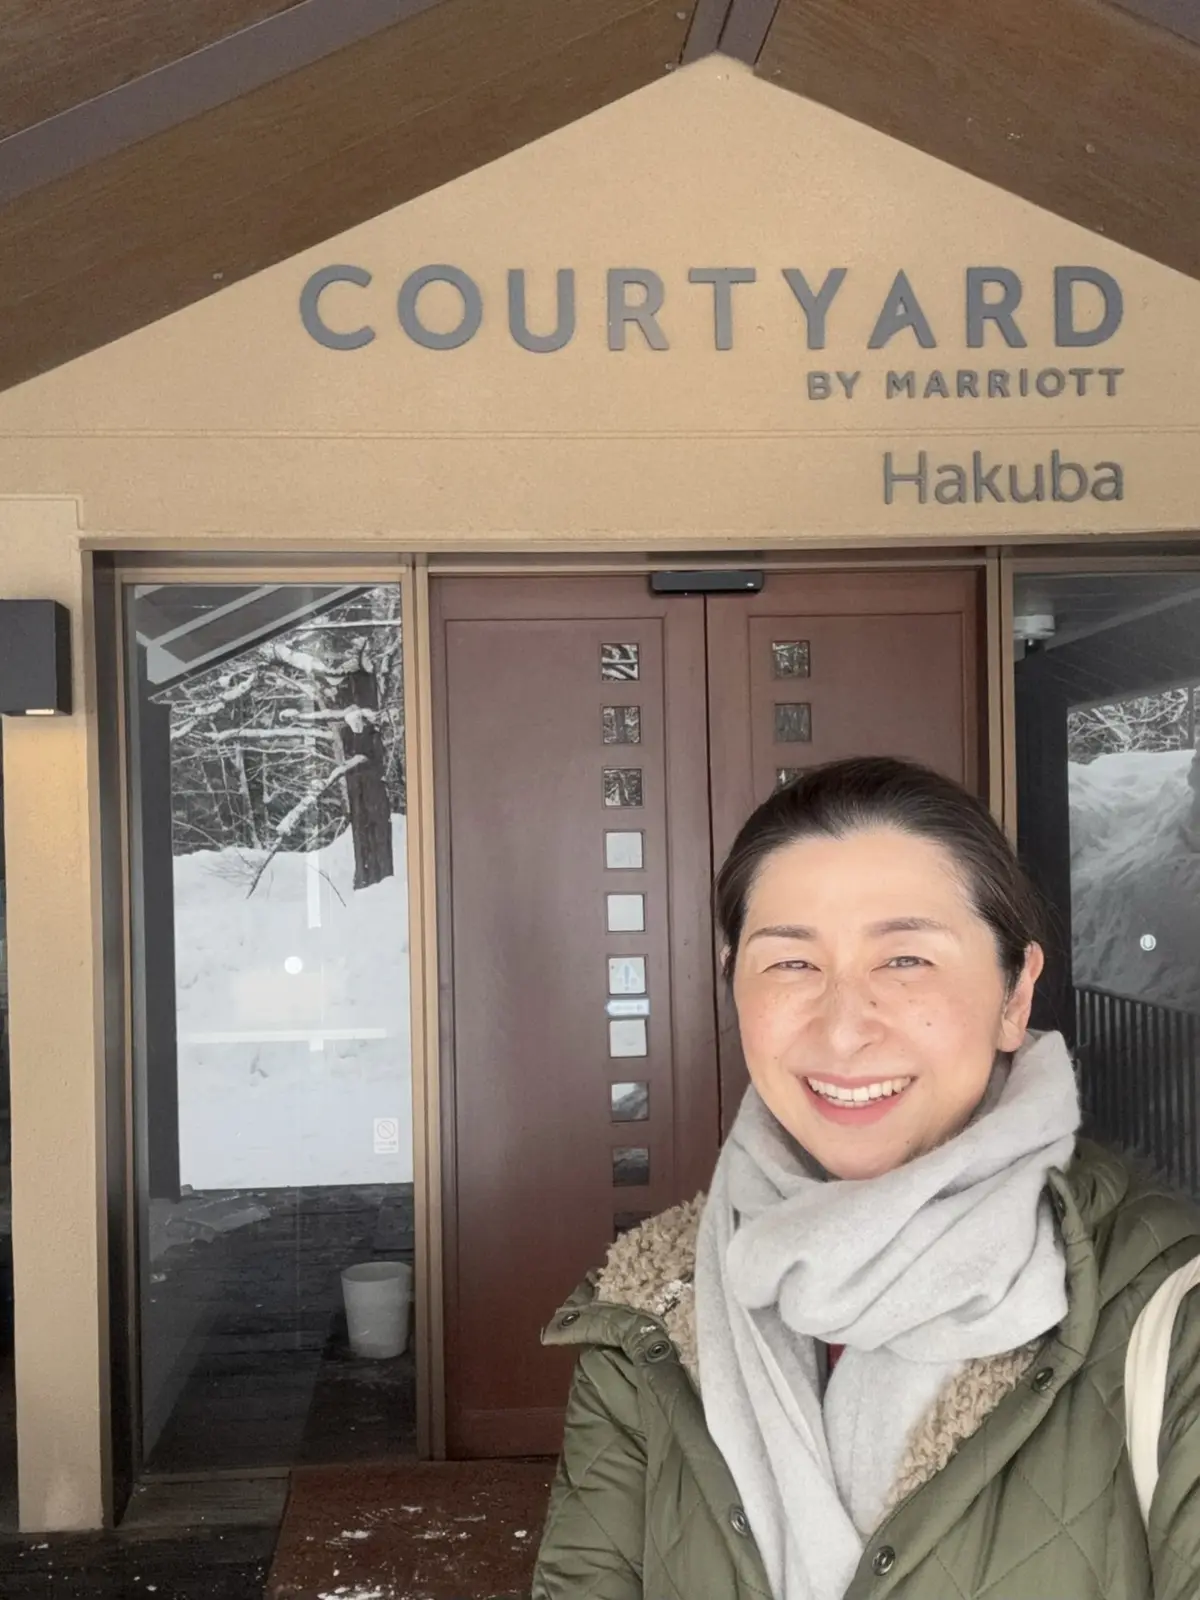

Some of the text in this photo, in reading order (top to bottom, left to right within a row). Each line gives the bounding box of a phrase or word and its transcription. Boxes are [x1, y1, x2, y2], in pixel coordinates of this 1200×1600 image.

[299, 264, 1124, 352] COURTYARD
[807, 368, 1125, 401] BY MARRIOTT
[882, 449, 1124, 505] Hakuba
